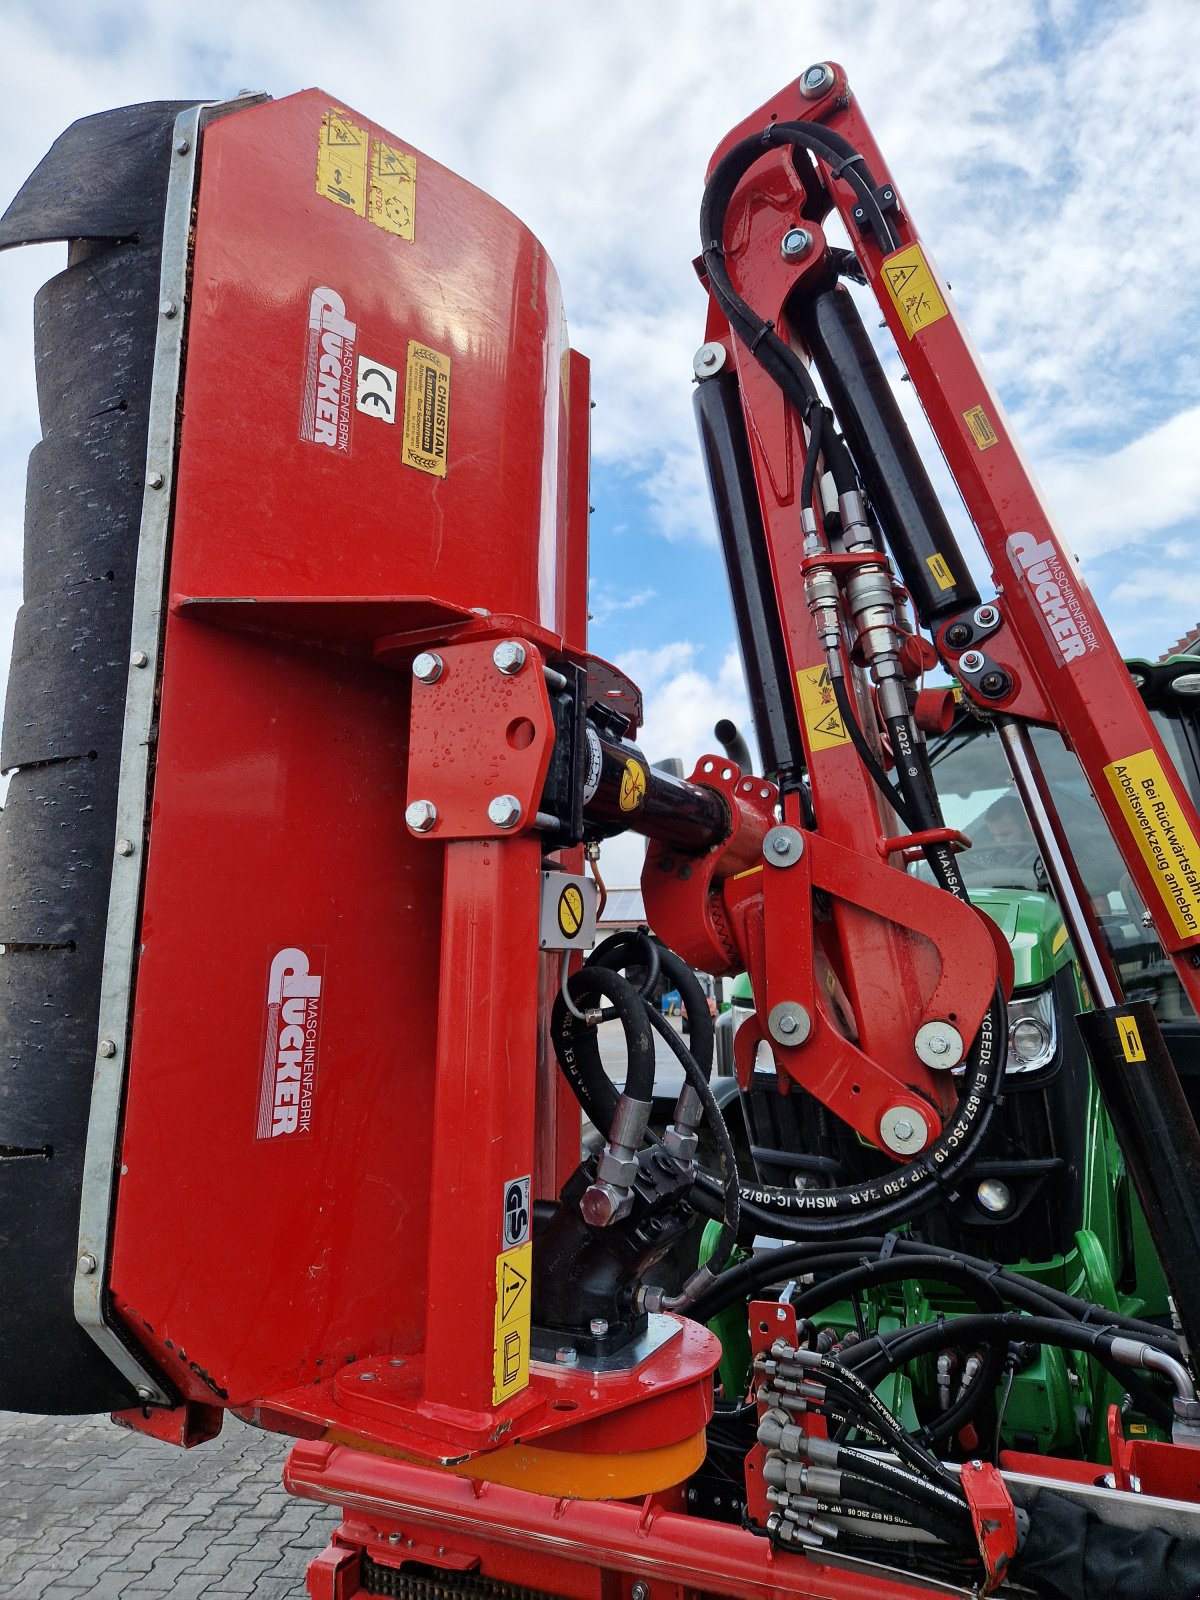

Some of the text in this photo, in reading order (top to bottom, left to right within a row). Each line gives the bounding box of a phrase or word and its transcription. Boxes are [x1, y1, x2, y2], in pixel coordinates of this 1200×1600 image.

[375, 188, 383, 215] STOP
[338, 340, 354, 452] MASCHINENFABRIK
[361, 368, 392, 415] CE
[423, 371, 435, 449] Landmaschinen
[435, 373, 447, 458] E. CHRISTIAN
[1048, 556, 1100, 652] MASCHINENFABRIK
[896, 725, 912, 755] 2Q22
[1141, 778, 1160, 800] Bei
[1115, 766, 1198, 930] Arbeitswerkzeug anheben
[299, 999, 319, 1132] MASCHINENFABRIK
[964, 1095, 981, 1120] 857
[948, 1120, 969, 1147] 2SC
[935, 1148, 949, 1163] 19
[739, 1188, 791, 1207] IC-08/2
[796, 1196, 837, 1208] MSHA
[884, 1181, 908, 1195] 280
[507, 1185, 528, 1239] GS
[855, 1380, 866, 1390] KP
[868, 1392, 902, 1432] HANSA-FLEX
[880, 1461, 918, 1484] PERFORMANCE
